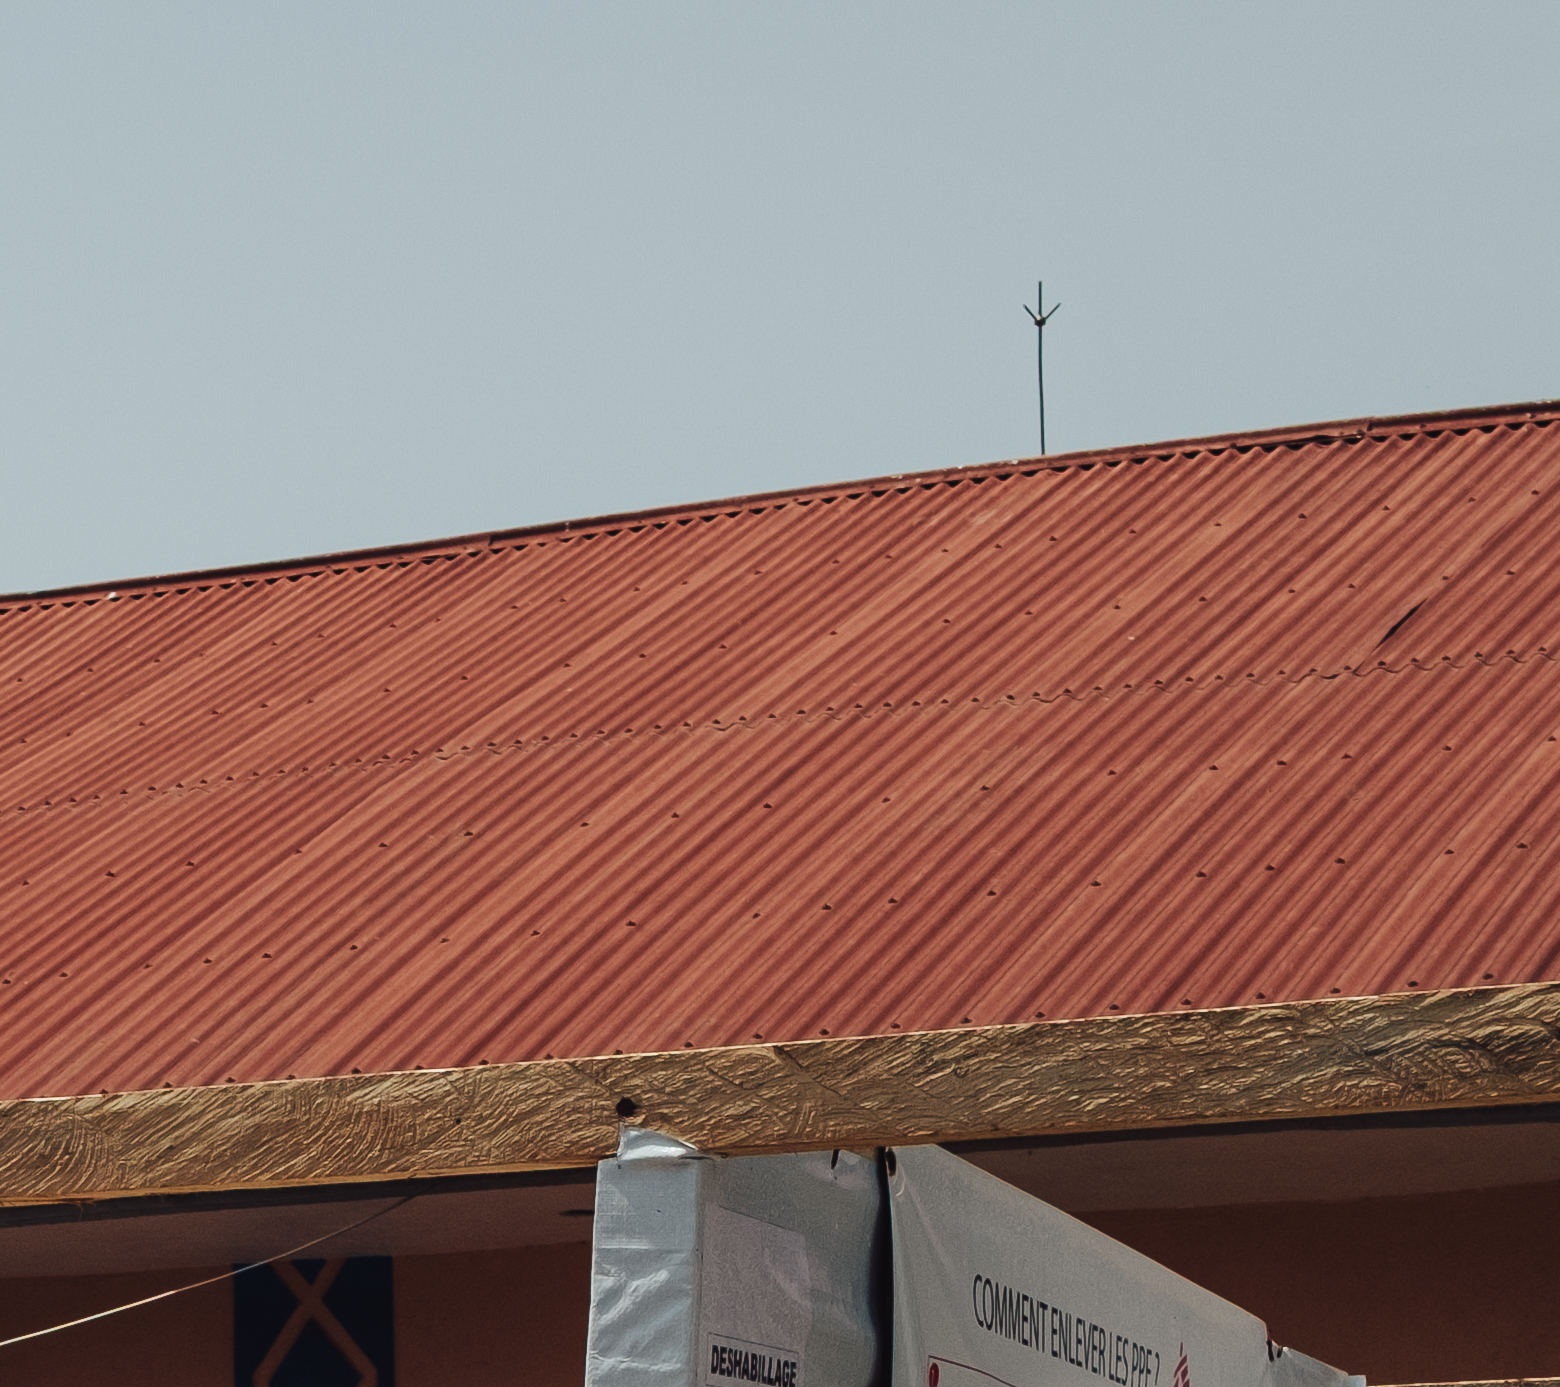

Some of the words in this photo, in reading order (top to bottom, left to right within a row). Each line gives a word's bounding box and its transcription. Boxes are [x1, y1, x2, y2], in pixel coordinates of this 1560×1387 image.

[972, 1273, 1048, 1353] COMMENT
[1051, 1306, 1106, 1378] ENLEVER
[1108, 1332, 1128, 1387] LES
